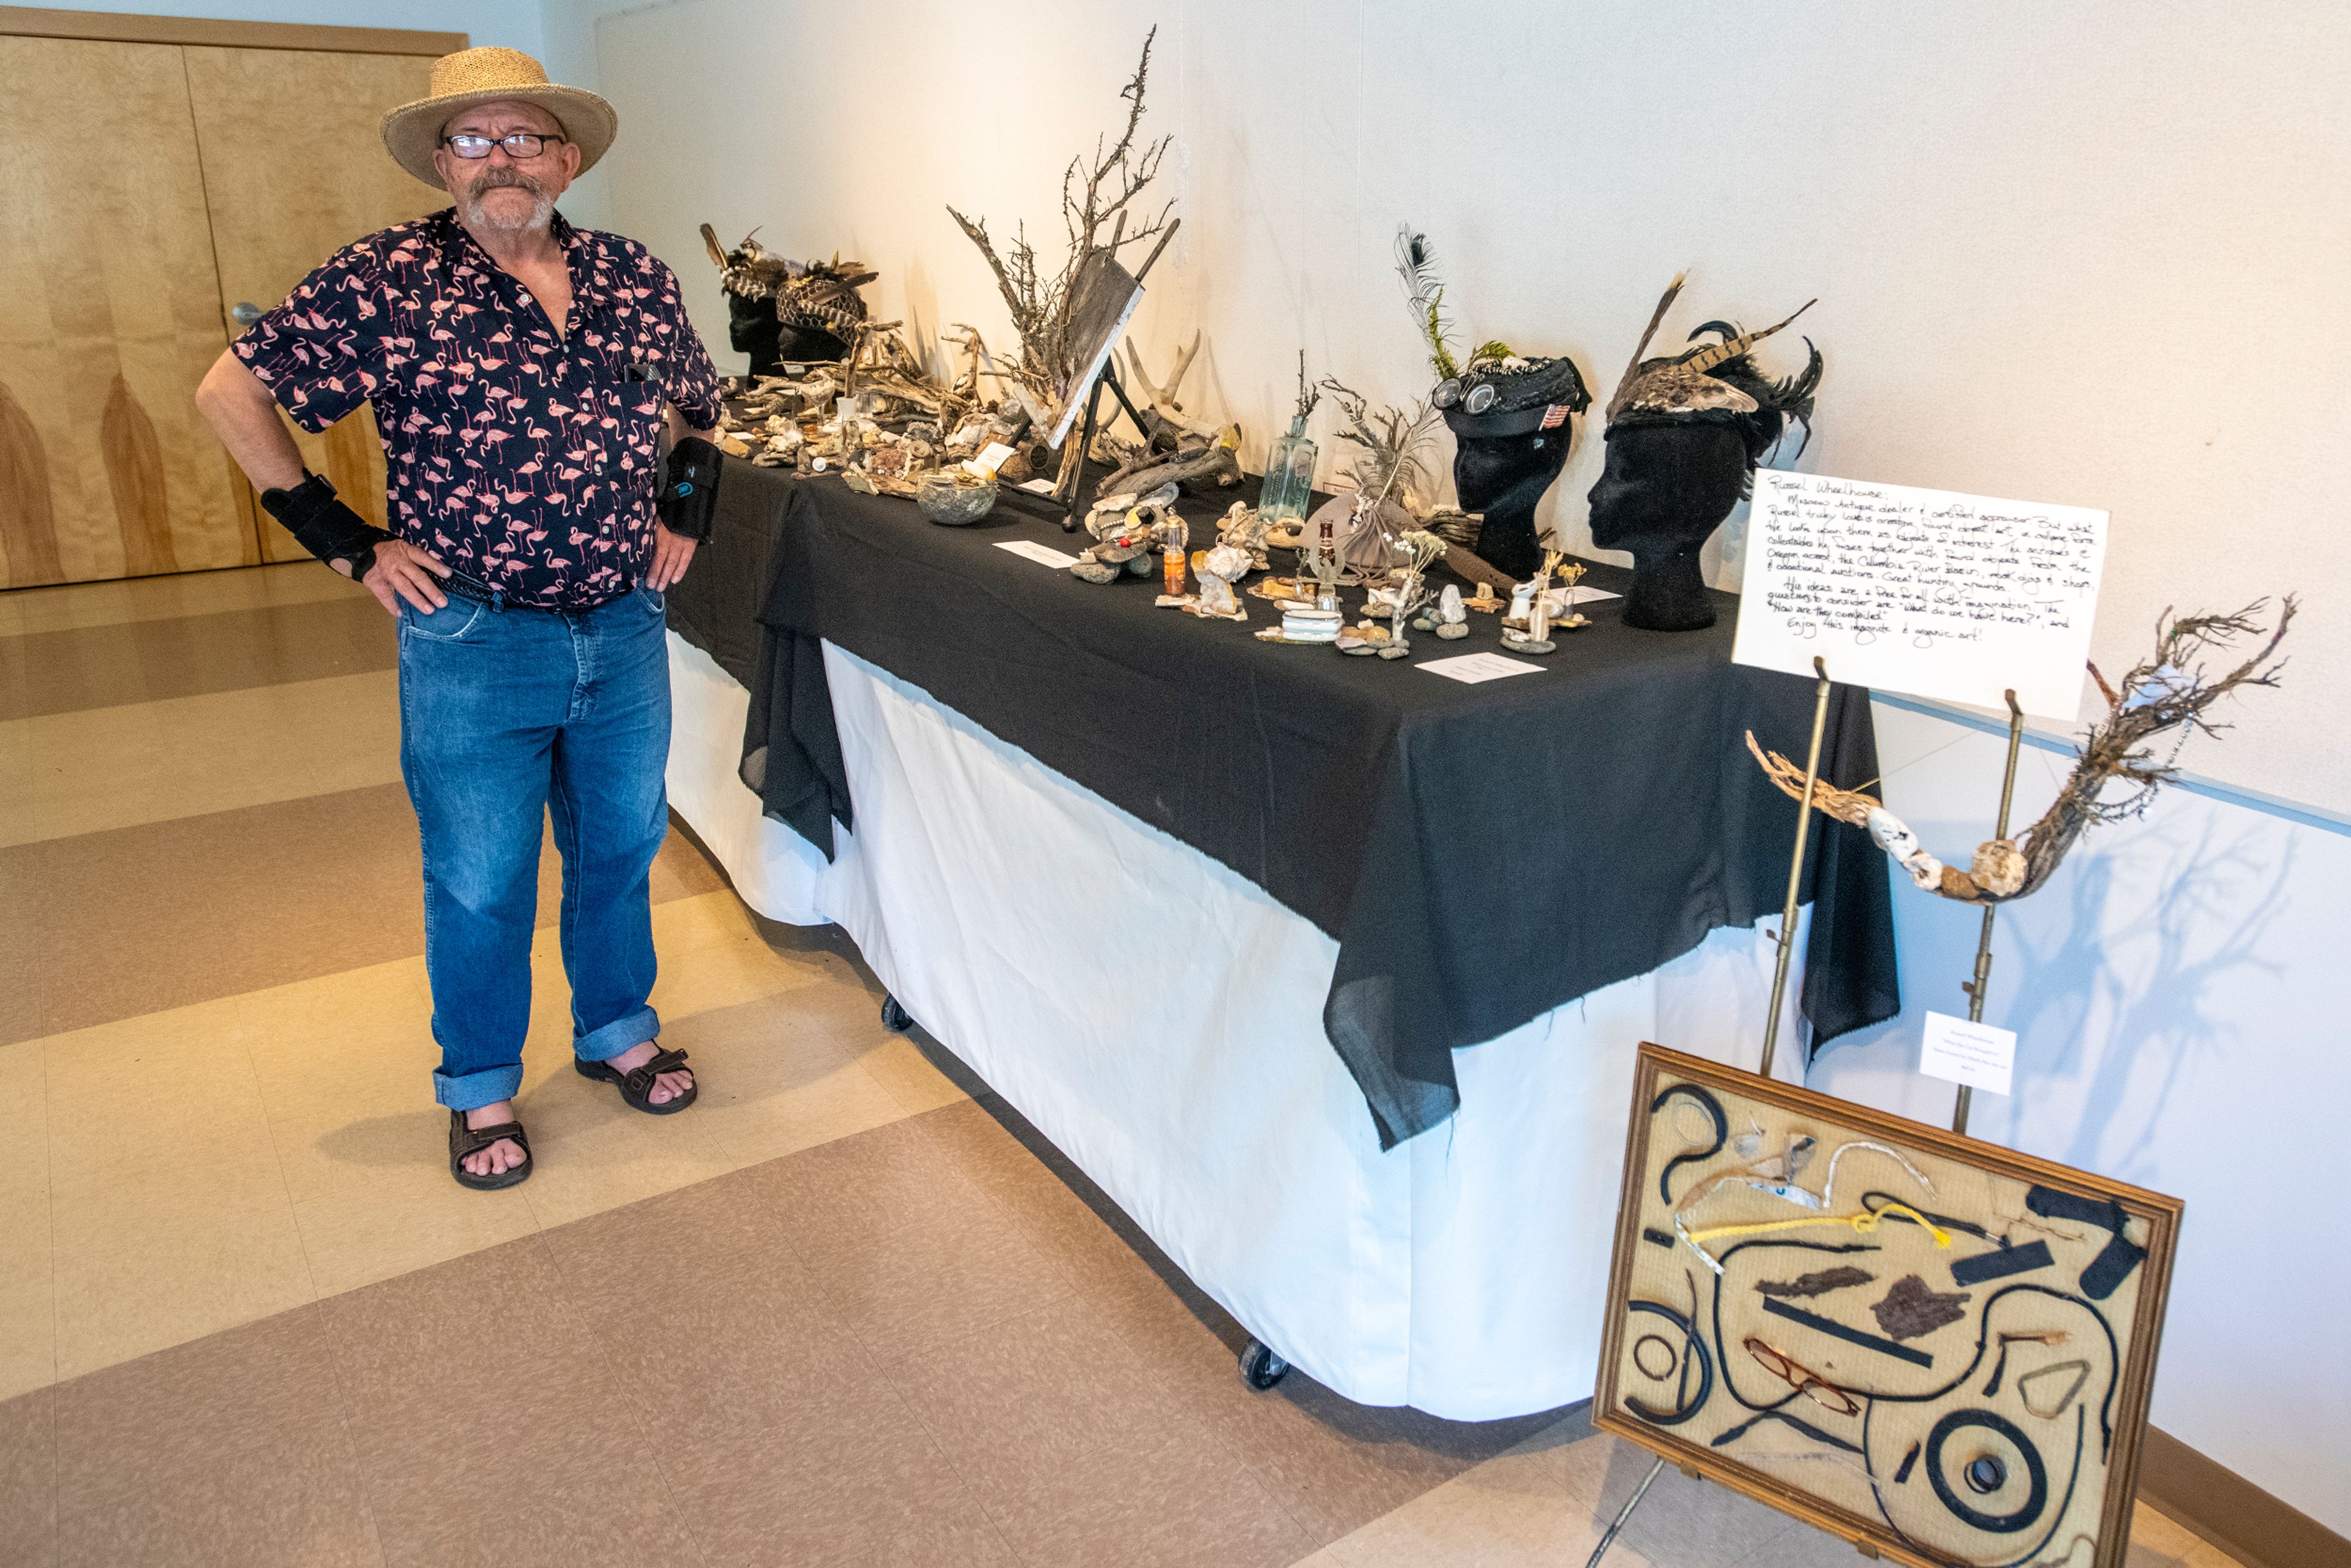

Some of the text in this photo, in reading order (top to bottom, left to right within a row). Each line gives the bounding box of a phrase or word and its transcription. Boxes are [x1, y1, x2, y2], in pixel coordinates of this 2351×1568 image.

[1768, 475, 1807, 495] Russel
[1767, 504, 1801, 523] Russel
[1879, 501, 1914, 514] dealer
[1768, 548, 1800, 565] Oregon
[1838, 553, 1854, 564] the
[1907, 560, 1941, 576] River
[1807, 580, 1832, 592] ideas
[1882, 571, 1911, 582] Great
[1787, 617, 1817, 639] Enjoy
